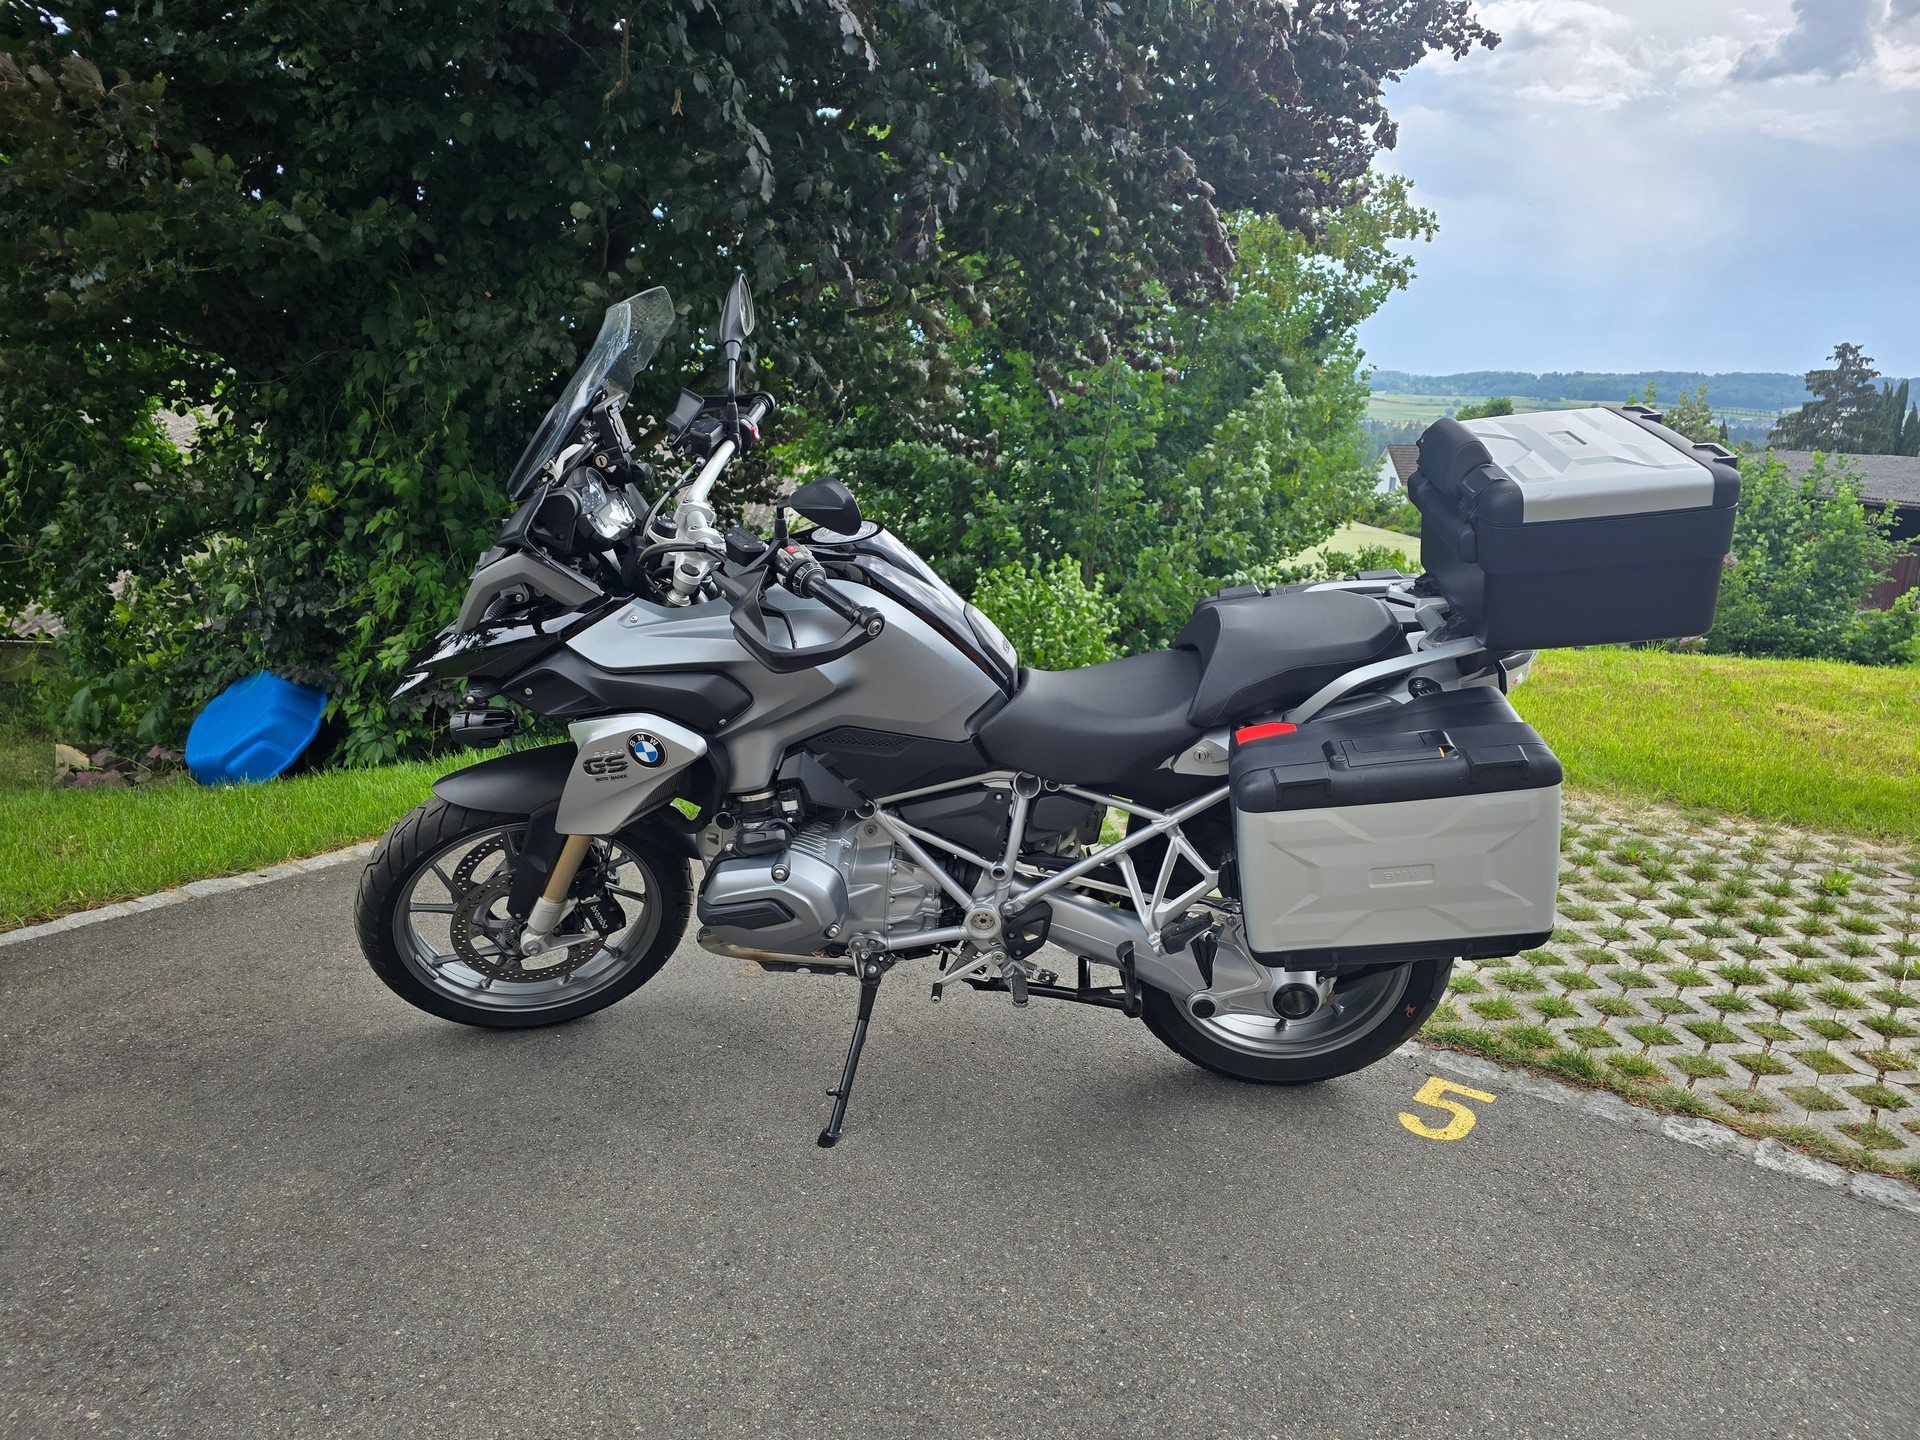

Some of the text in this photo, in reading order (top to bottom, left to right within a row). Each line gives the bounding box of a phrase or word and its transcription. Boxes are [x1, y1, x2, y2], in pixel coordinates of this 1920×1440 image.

[629, 735, 659, 748] BMW
[583, 754, 628, 775] GS
[590, 904, 608, 929] brembo
[1398, 1076, 1497, 1141] 5
